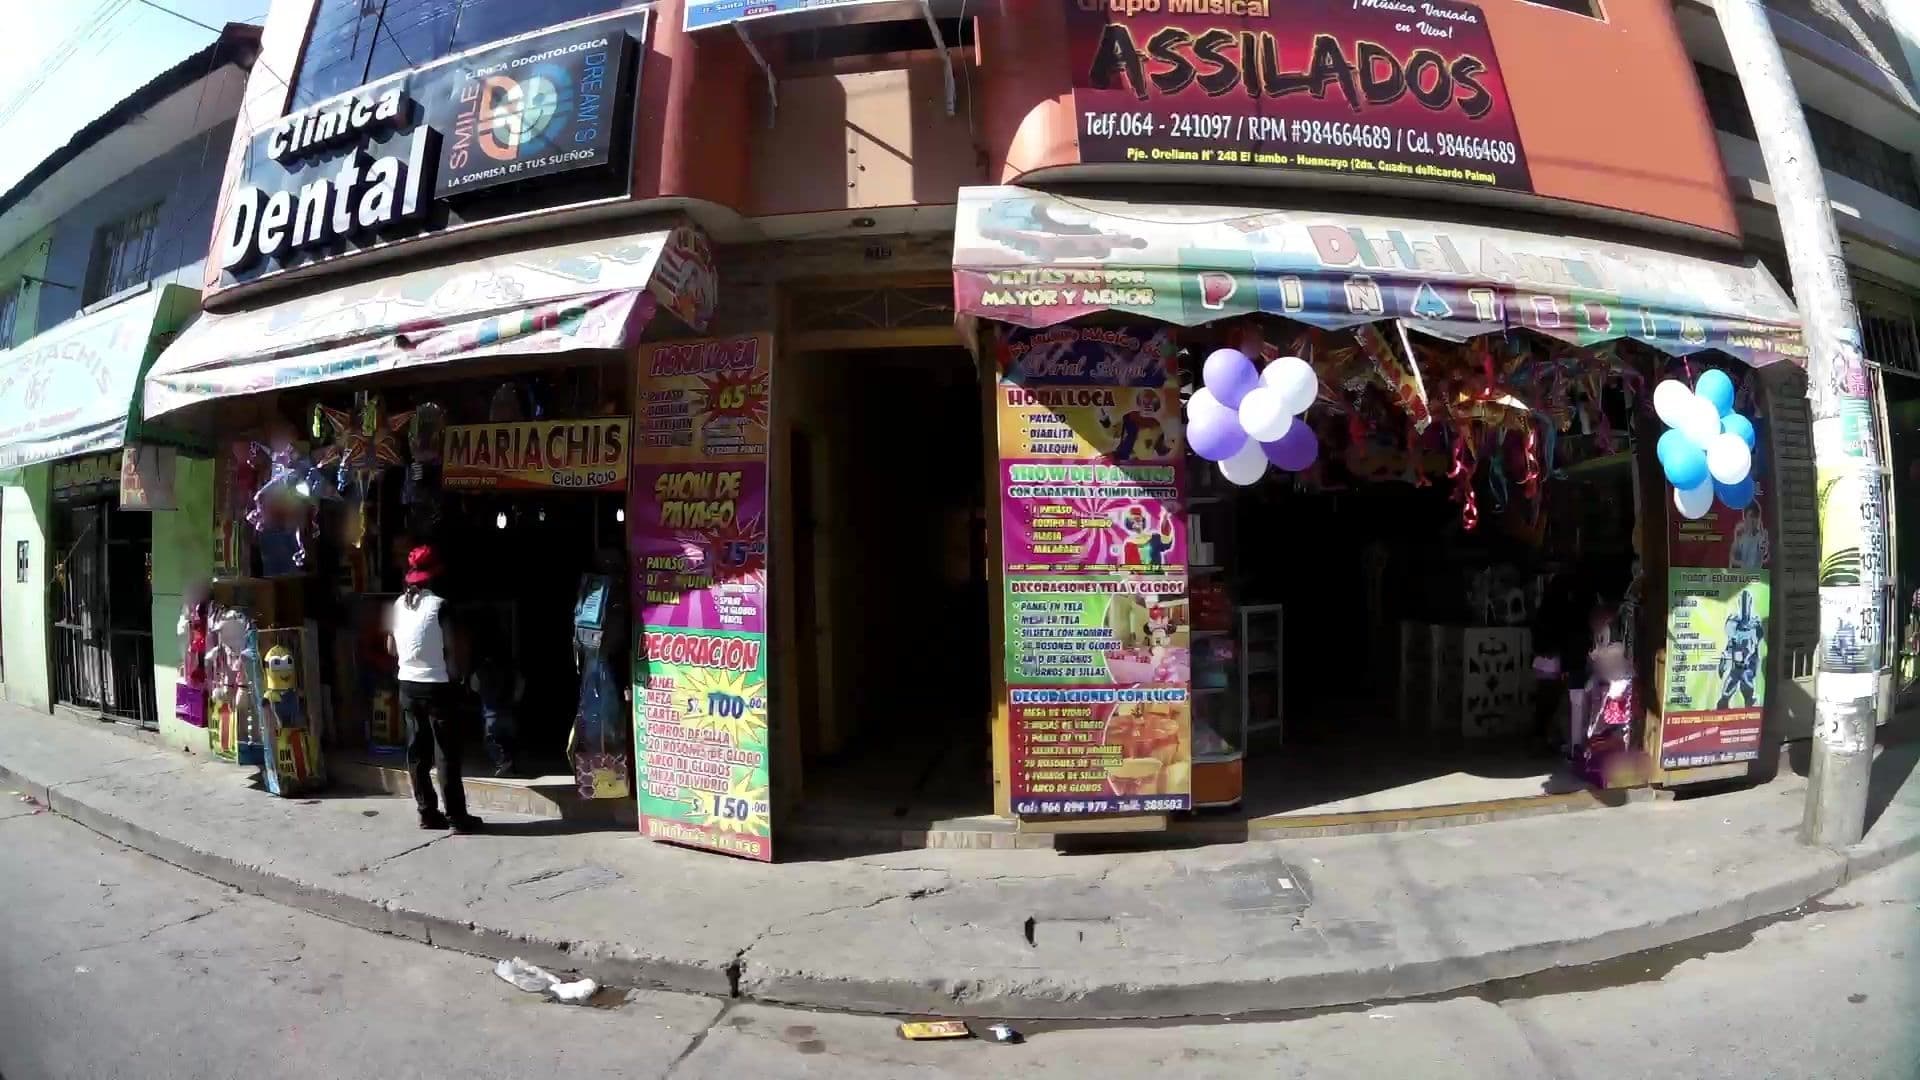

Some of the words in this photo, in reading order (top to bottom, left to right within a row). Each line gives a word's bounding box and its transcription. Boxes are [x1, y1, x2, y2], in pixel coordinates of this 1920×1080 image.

[1079, 0, 1160, 16] Grupo
[1167, 0, 1270, 17] Musical
[1420, 3, 1478, 25] Variada
[1395, 23, 1412, 33] en
[1416, 21, 1453, 39] Vivo!
[465, 63, 508, 82] CLINICA
[512, 38, 609, 68] ODONTOLOGICA
[1088, 23, 1494, 119] ASSILADOS
[449, 80, 480, 170] SMILE
[1169, 113, 1233, 139] 241097
[1248, 117, 1288, 142] RPM
[1291, 119, 1391, 152] #984664689
[1407, 128, 1434, 156] Cel.
[1437, 132, 1516, 164] 984664689
[447, 178, 461, 189] LA
[461, 167, 507, 185] SONRISA
[509, 160, 524, 174] DE
[526, 155, 547, 170] TUS
[549, 147, 597, 167] SUEÑOS
[1127, 148, 1148, 160] Pje.
[1151, 149, 1198, 161] Orellana
[1217, 151, 1236, 162] 248
[1239, 151, 1251, 162] El
[1254, 152, 1287, 164] tambo
[1297, 154, 1348, 169] Huancayo
[1378, 160, 1413, 174] Cuadra
[1465, 169, 1497, 185] Palma)
[220, 123, 429, 269] Dental
[981, 289, 1059, 306] MAYOR
[1061, 290, 1077, 305] Y
[1083, 288, 1155, 306] MENOR
[1007, 389, 1066, 408] HORA
[1070, 389, 1116, 408] LOCA
[1029, 414, 1067, 424] PAYASO
[445, 424, 623, 472] MARIACHIS
[1031, 443, 1079, 453] ARLEQUIN
[551, 470, 583, 488] Cielo
[587, 468, 618, 487] Rojo
[655, 471, 714, 500] SHOW
[716, 470, 743, 498] DE
[660, 500, 737, 529] PAYASO
[1011, 582, 1098, 593] DECORACIONES
[1064, 602, 1083, 611] TELA
[638, 632, 760, 672] DECORACION
[1088, 641, 1121, 650] GLOBOS
[708, 692, 745, 719] 100
[714, 794, 750, 821] 150
